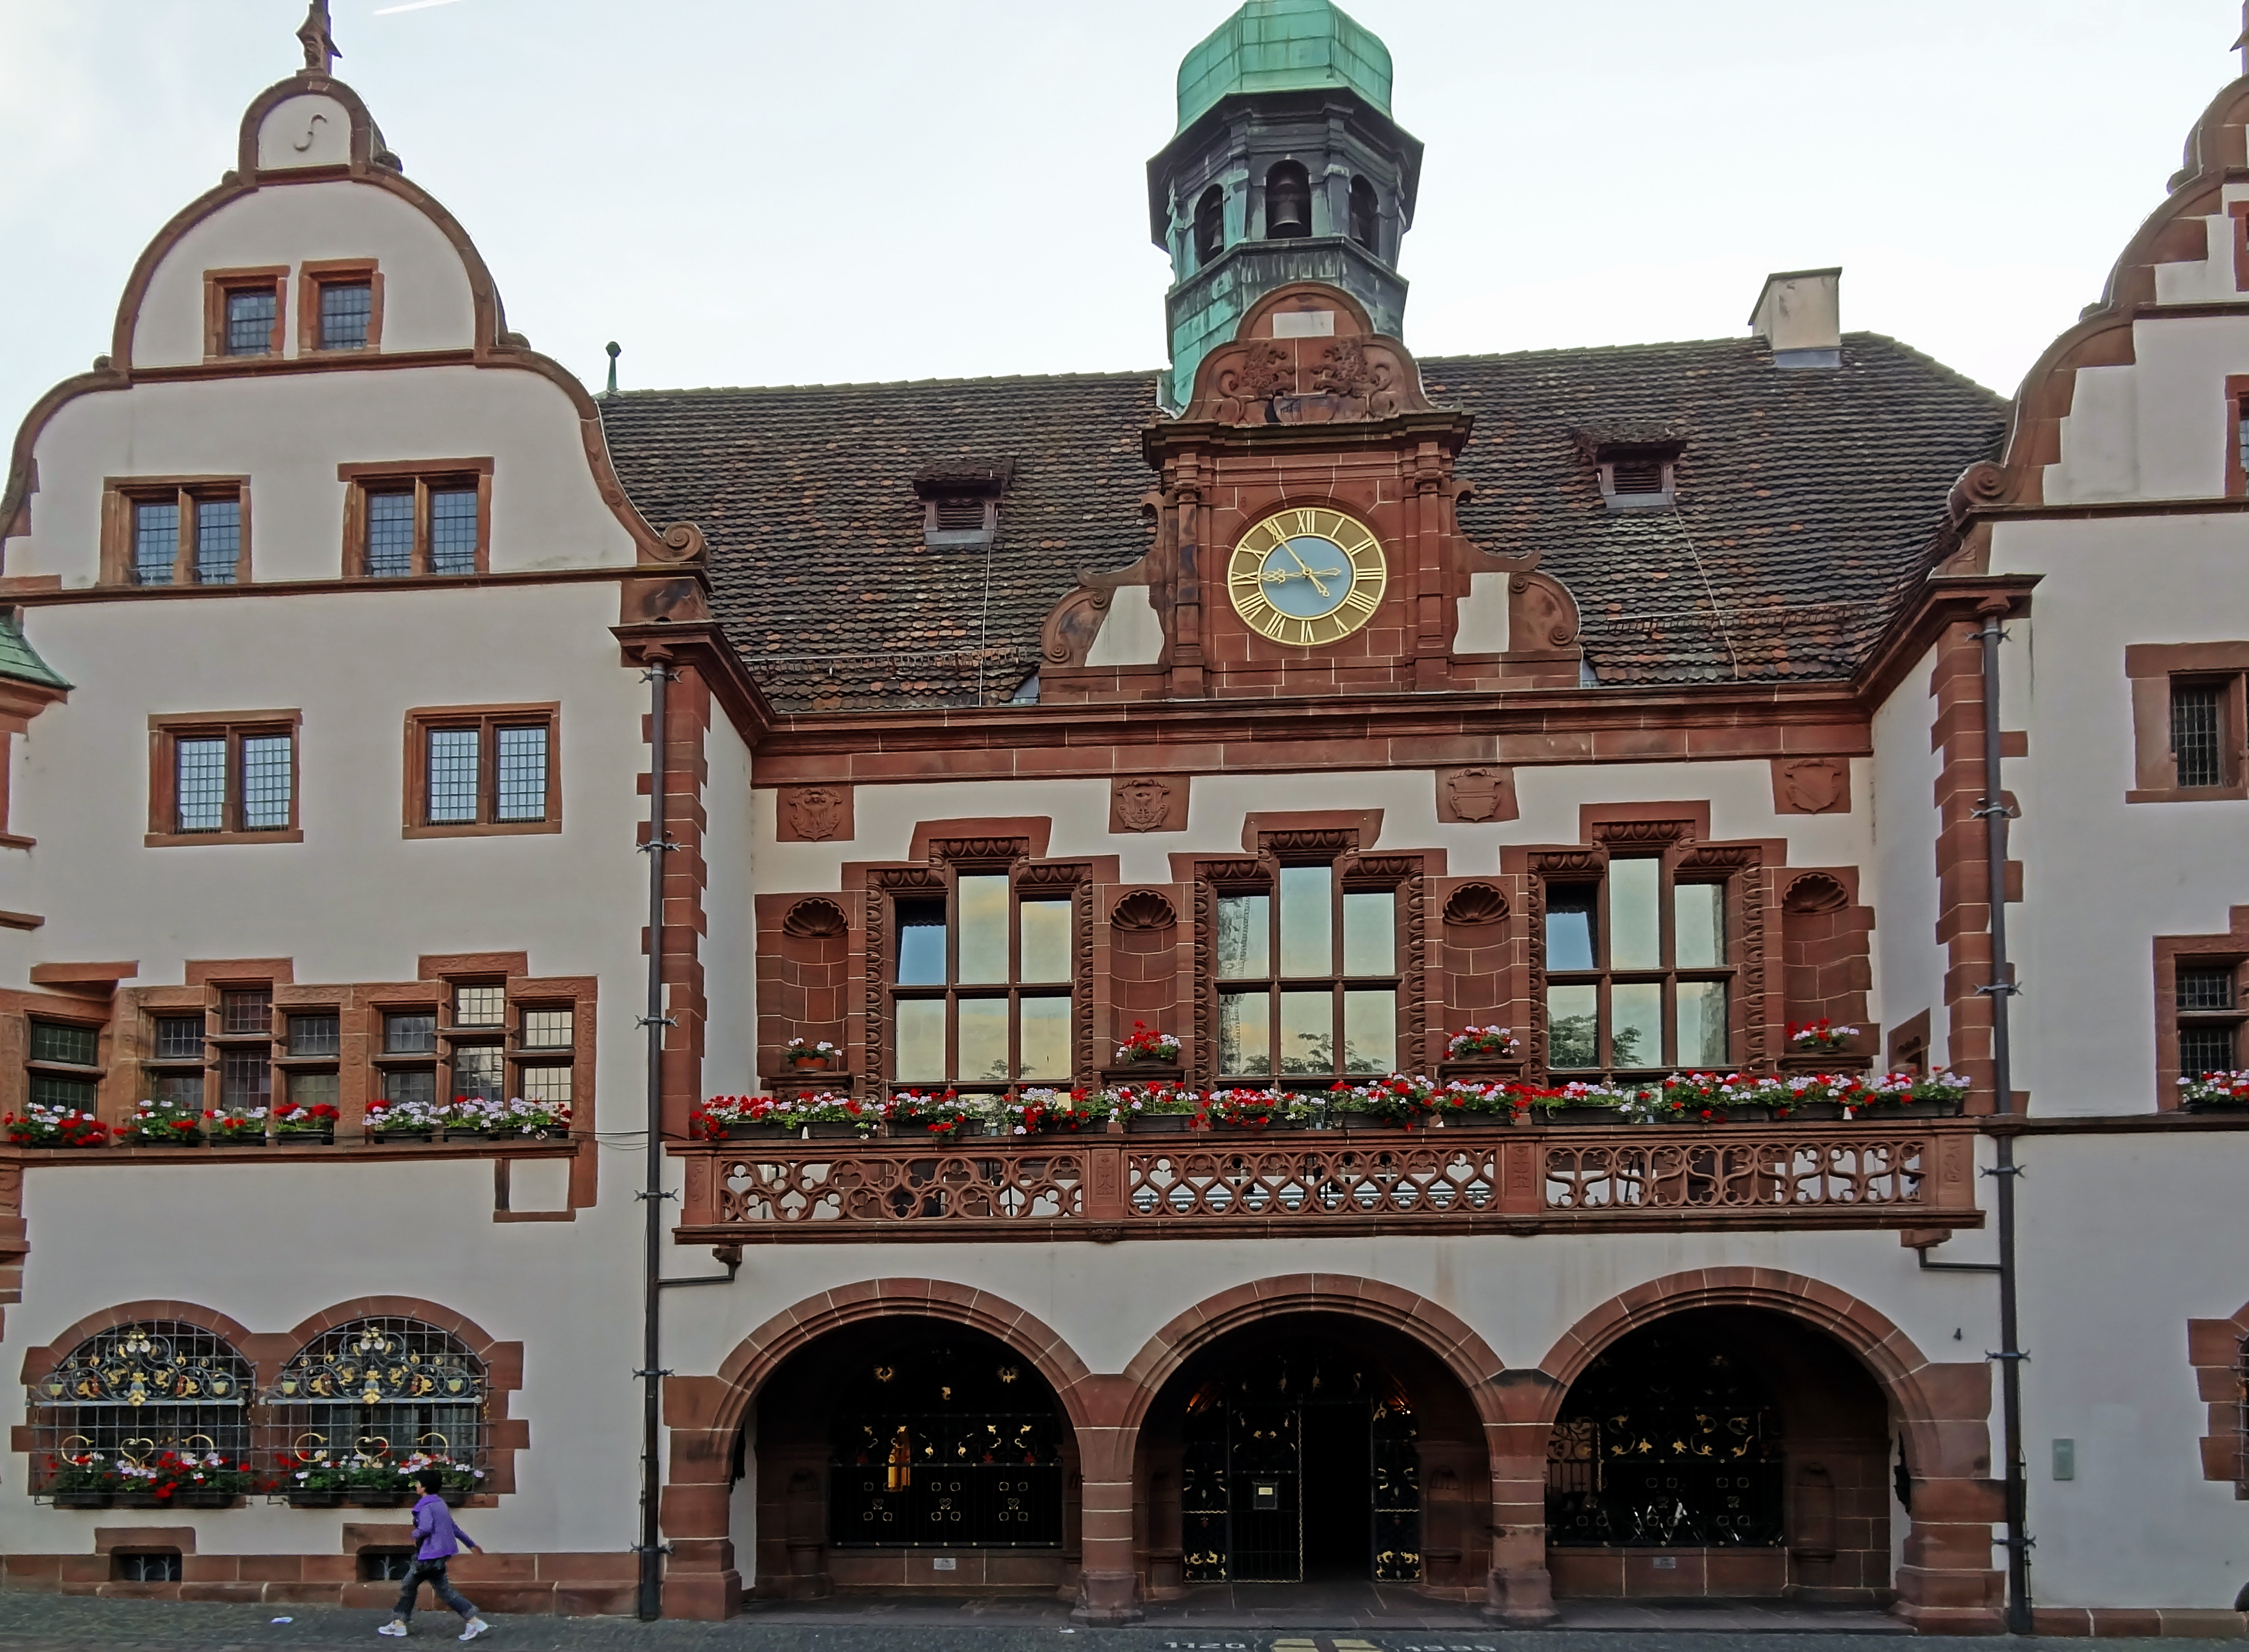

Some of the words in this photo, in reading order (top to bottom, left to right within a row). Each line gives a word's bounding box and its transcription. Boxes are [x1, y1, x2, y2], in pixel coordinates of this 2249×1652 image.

[1297, 511, 1315, 533] XII
[1239, 543, 1266, 560] X
[1349, 538, 1373, 556] II
[1232, 571, 1258, 585] IX
[1357, 568, 1382, 580] III
[1238, 592, 1266, 620] VIII
[1347, 590, 1376, 614] IIII
[1264, 612, 1286, 638] VII
[1301, 621, 1314, 642] VI
[1332, 613, 1349, 634] V
